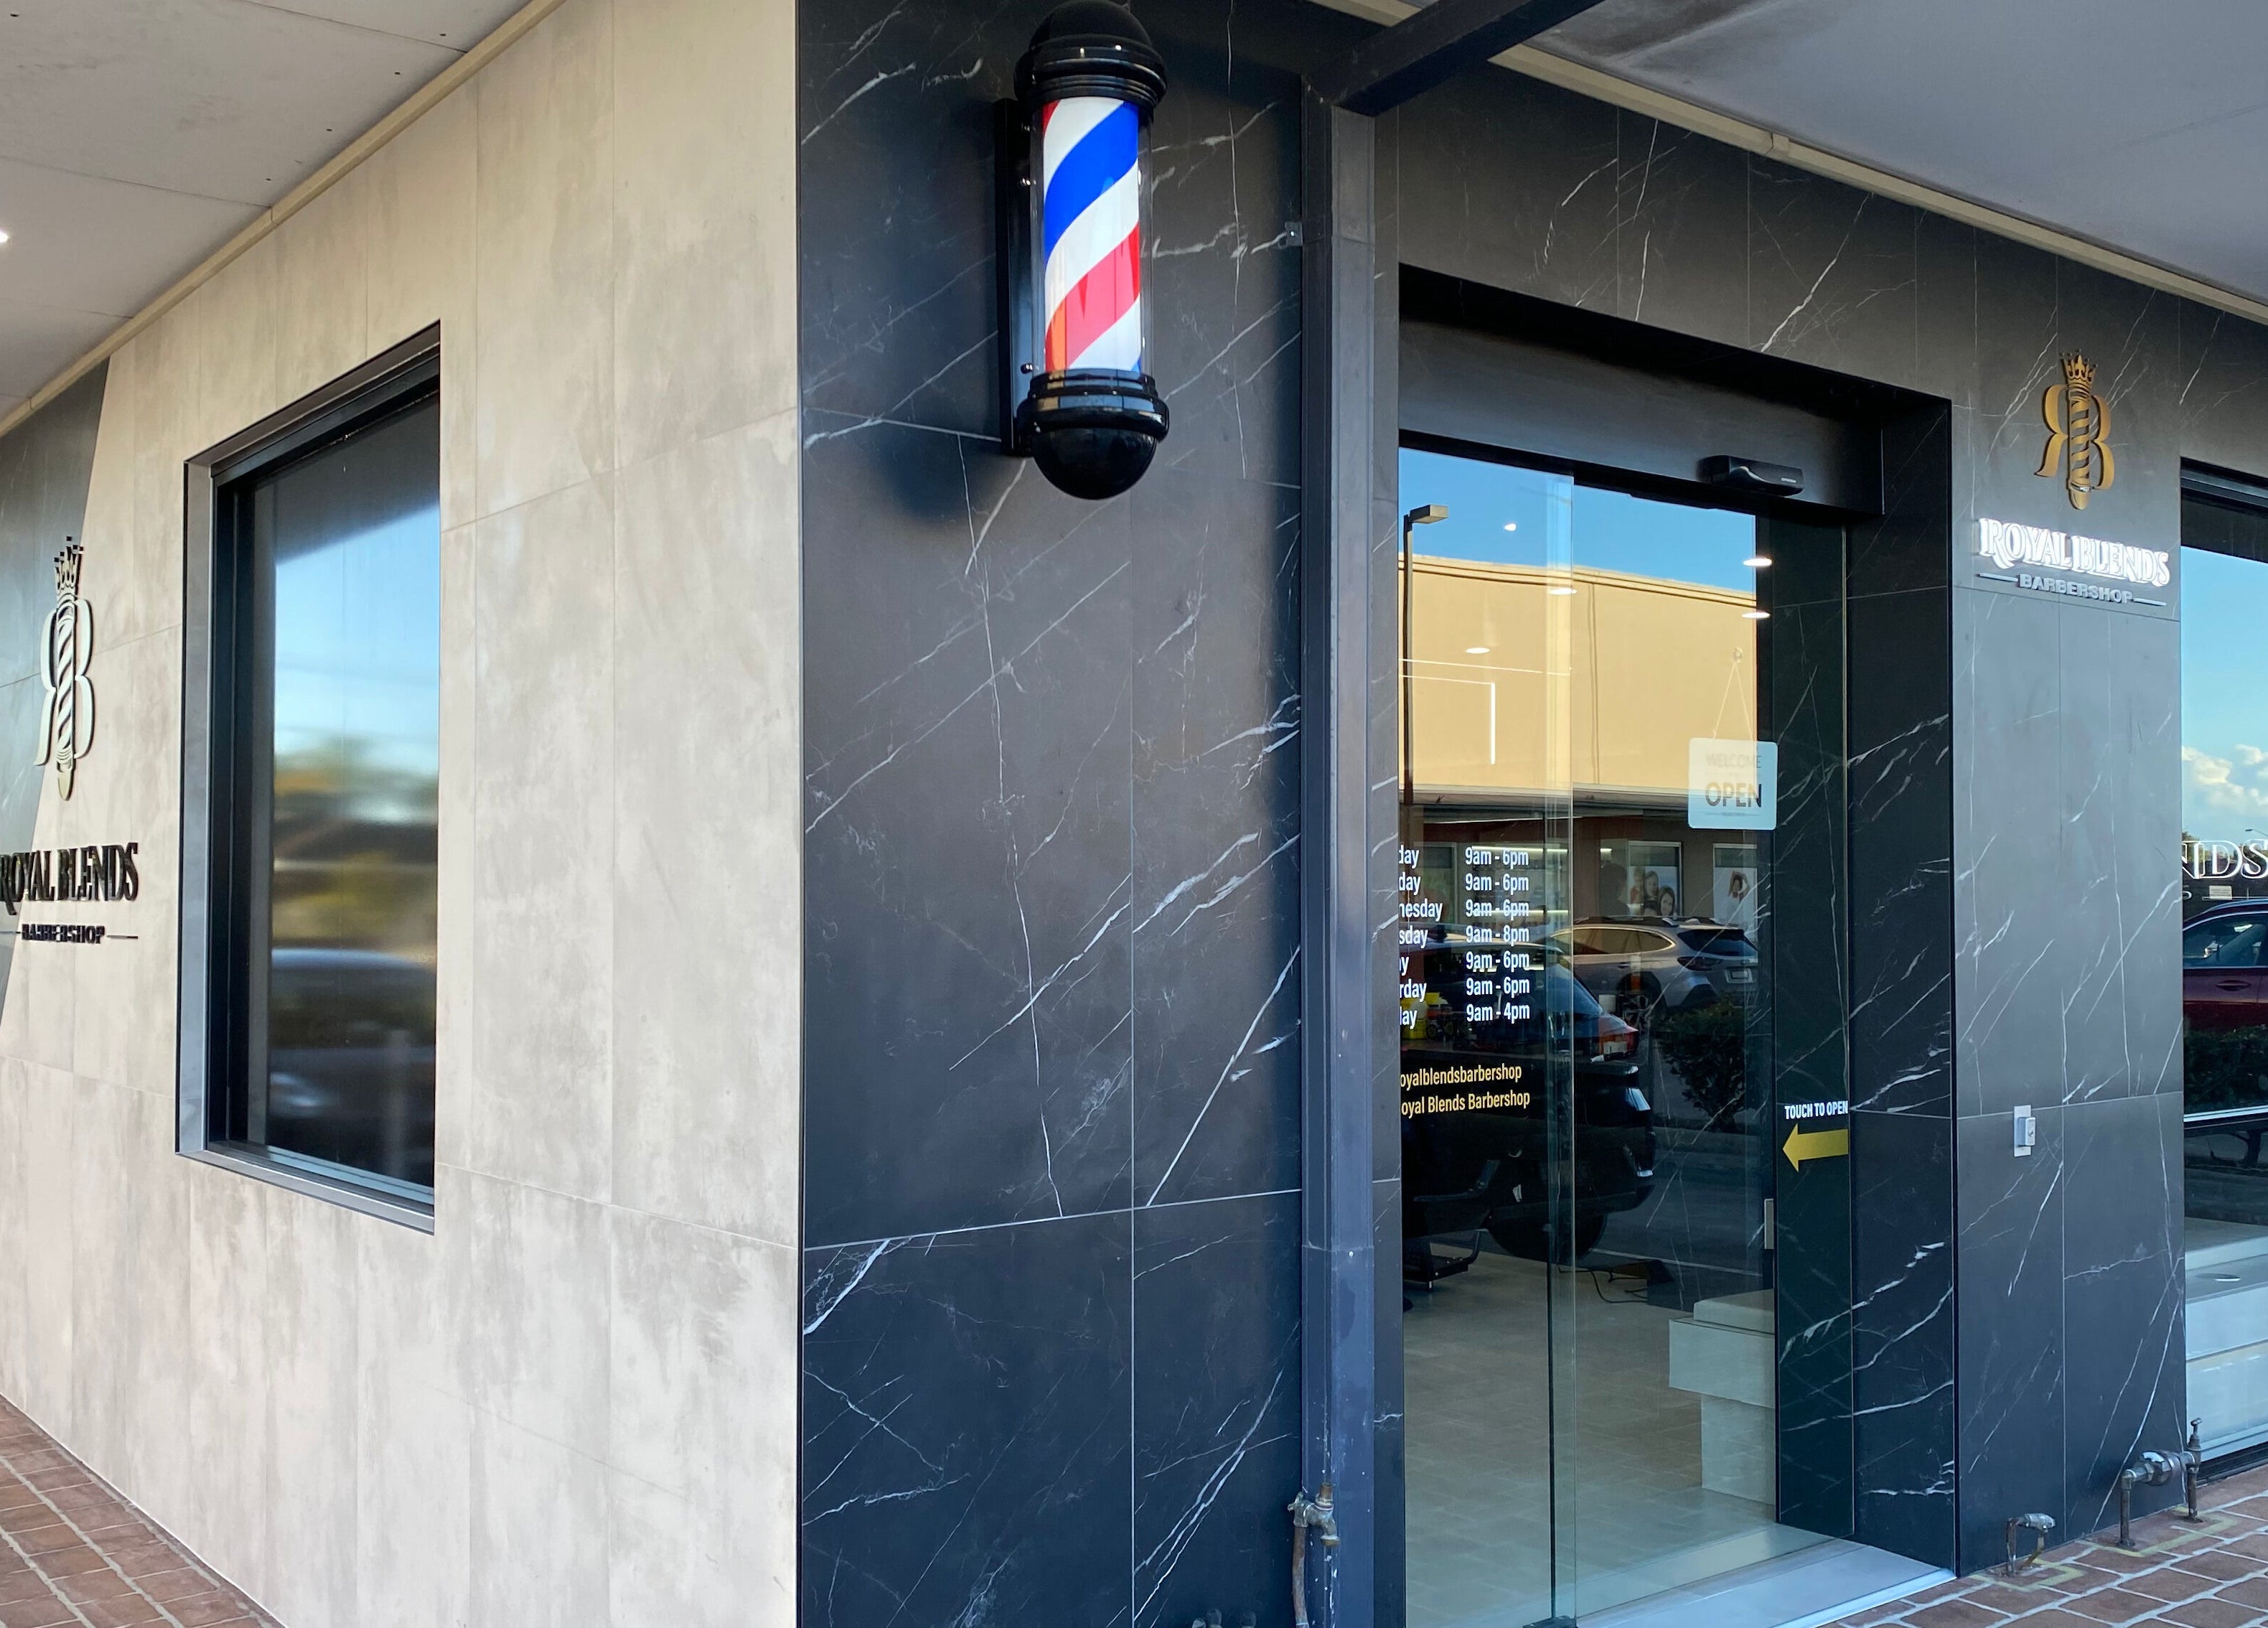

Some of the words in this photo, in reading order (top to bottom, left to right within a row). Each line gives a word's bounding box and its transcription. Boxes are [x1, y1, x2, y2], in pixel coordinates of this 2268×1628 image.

[1979, 518, 2072, 571] ROYAL
[2071, 535, 2170, 587] BLENDS
[2018, 574, 2133, 604] BARBERSHOP
[1705, 753, 1763, 769] WELCOME
[1705, 782, 1762, 808] OPEN
[1465, 846, 1492, 865] 9am
[1502, 848, 1529, 870] 6pm
[57, 842, 139, 902] BLENDS
[1465, 872, 1492, 891] 9am
[1502, 873, 1529, 896] 6pm
[1466, 899, 1493, 917] 9am
[1503, 899, 1529, 921] 6pm
[1466, 925, 1493, 943] 9am
[1503, 925, 1530, 947] 8pm
[1466, 951, 1493, 970] 9am
[1503, 950, 1530, 973] 6pm
[1466, 977, 1493, 996] 9am
[1503, 976, 1530, 998] 6pm
[1466, 1004, 1493, 1022] 9am
[1503, 1002, 1530, 1024] 4pm
[1428, 1093, 1466, 1113] Blends
[1468, 1089, 1530, 1109] Barbershop
[1784, 1103, 1813, 1120] TOUCH
[1814, 1102, 1825, 1117] TO
[1826, 1100, 1849, 1116] OPEN
